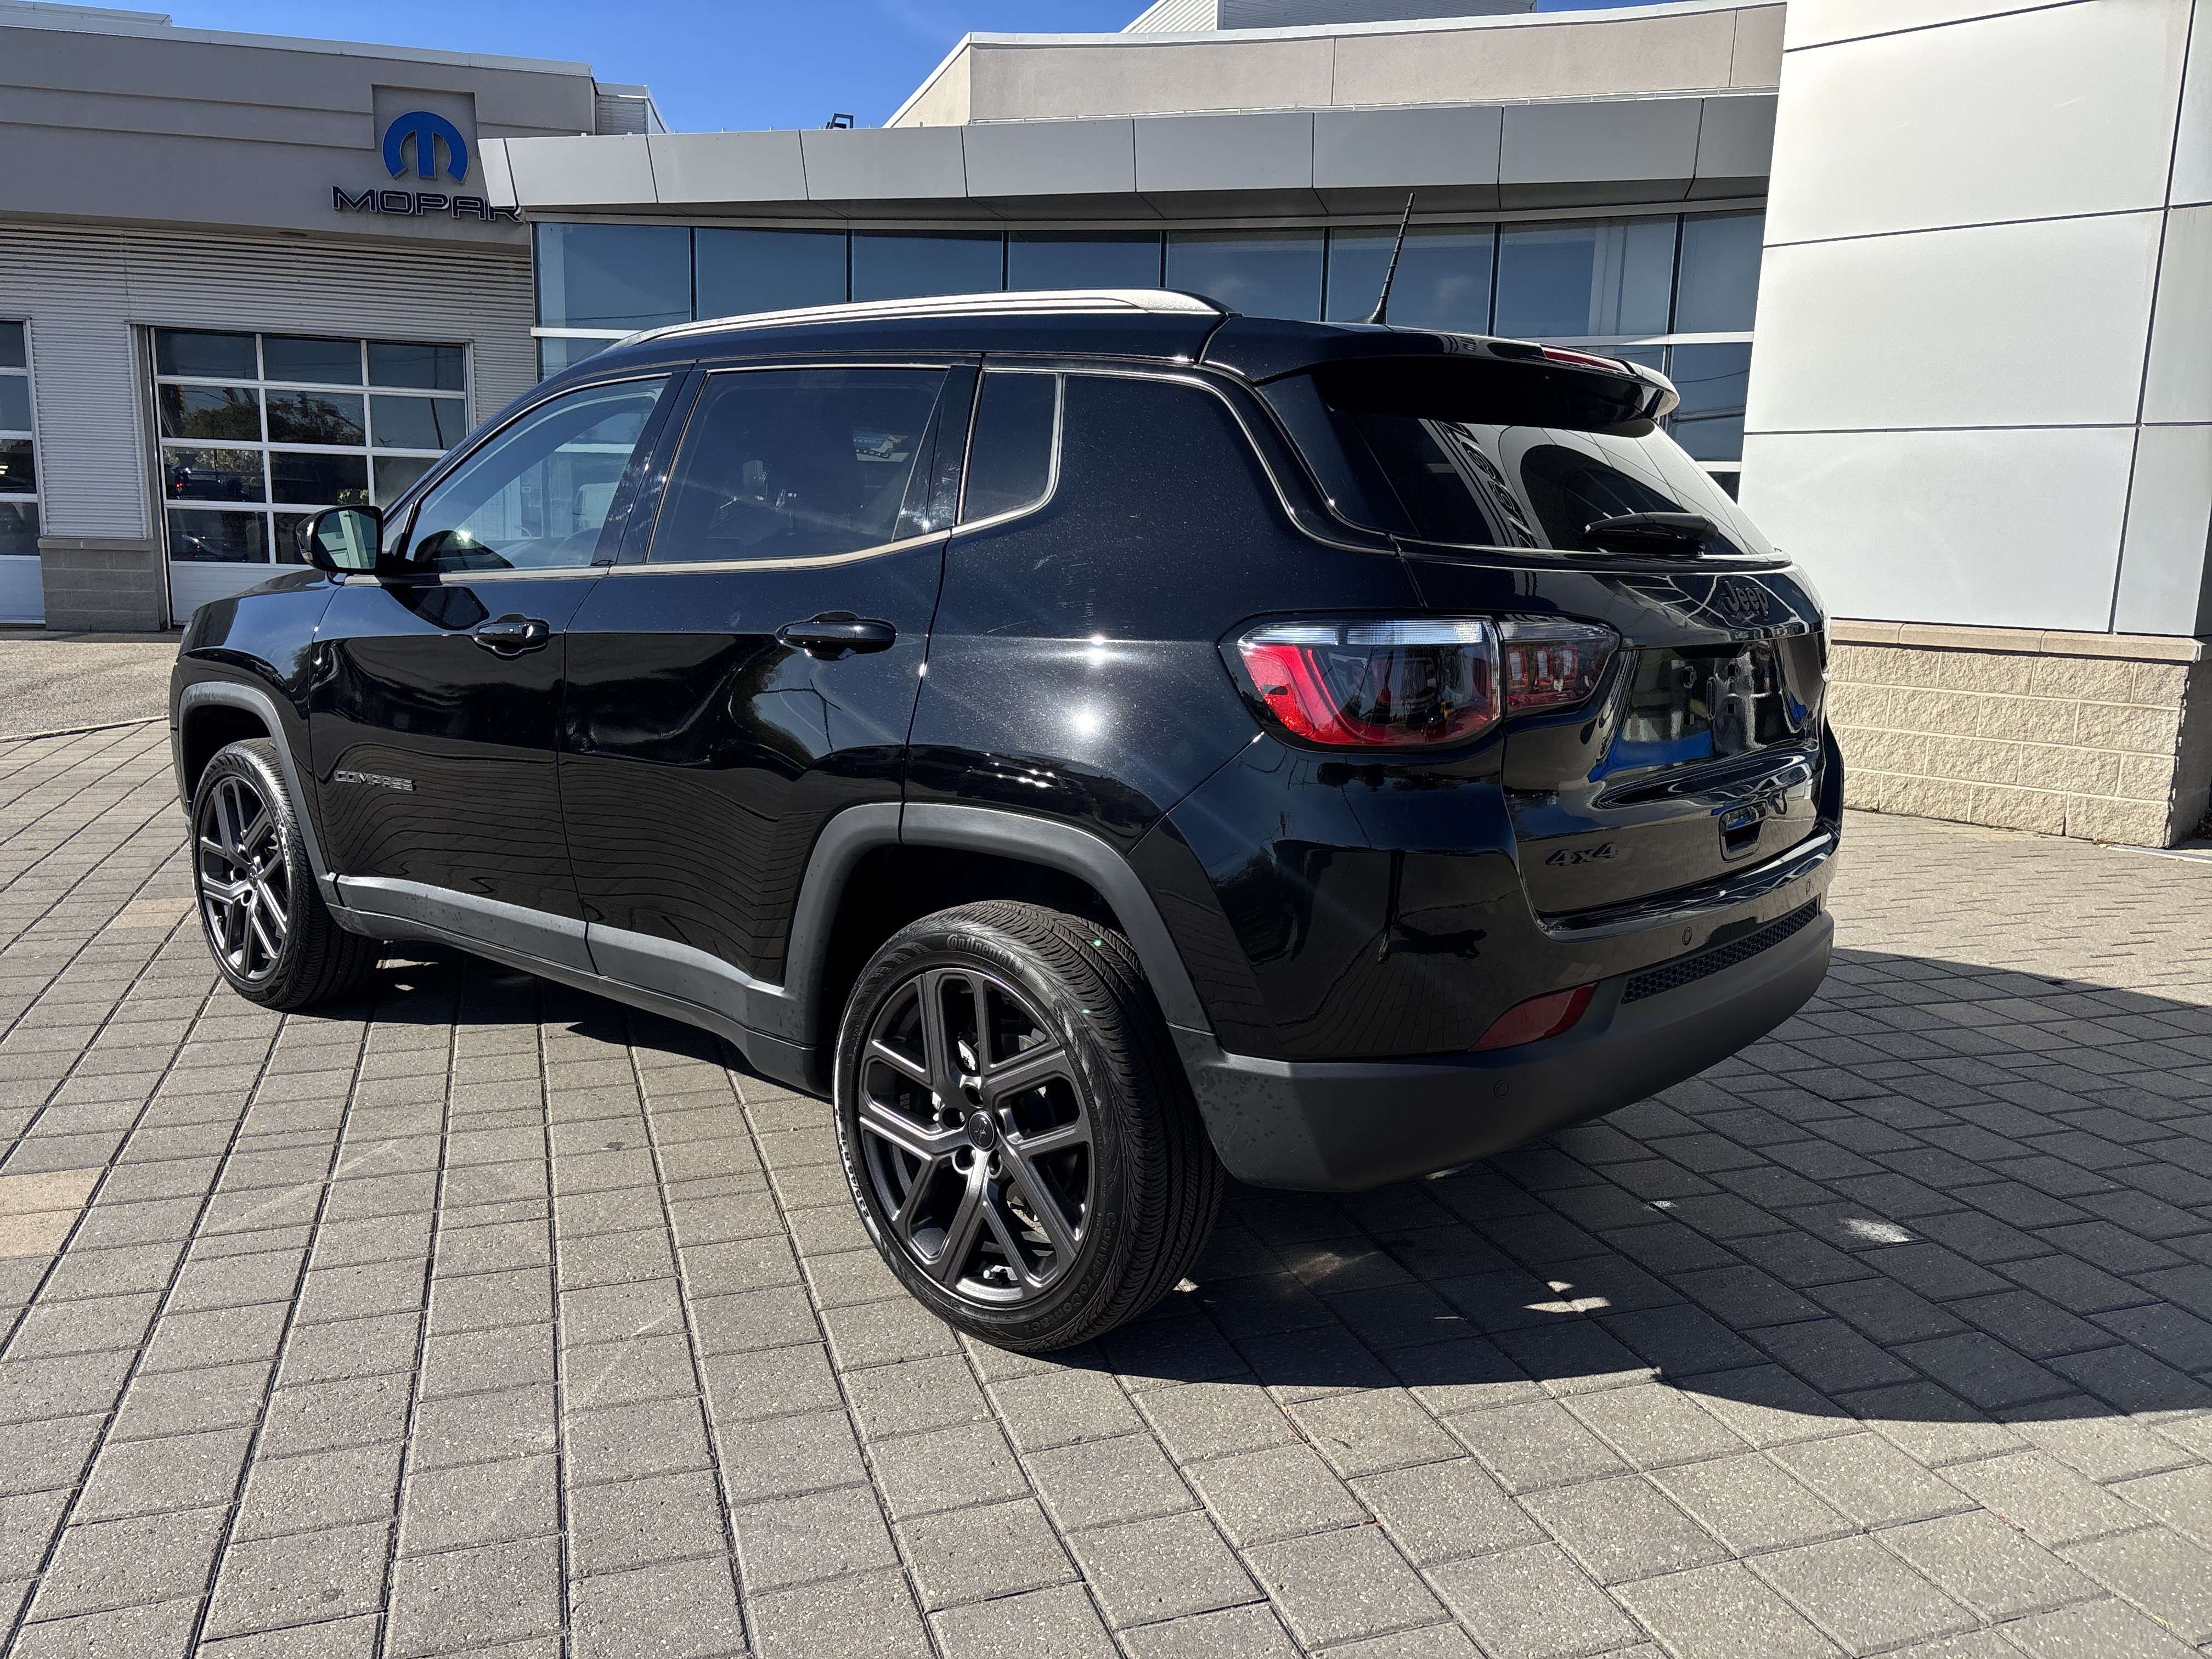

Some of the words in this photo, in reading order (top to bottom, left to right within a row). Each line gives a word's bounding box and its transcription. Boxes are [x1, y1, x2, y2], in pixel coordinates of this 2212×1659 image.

[331, 185, 522, 222] MOPAR
[1720, 579, 1769, 618] Jeep
[1545, 842, 1616, 866] 4x4
[946, 934, 1016, 968] Continental
